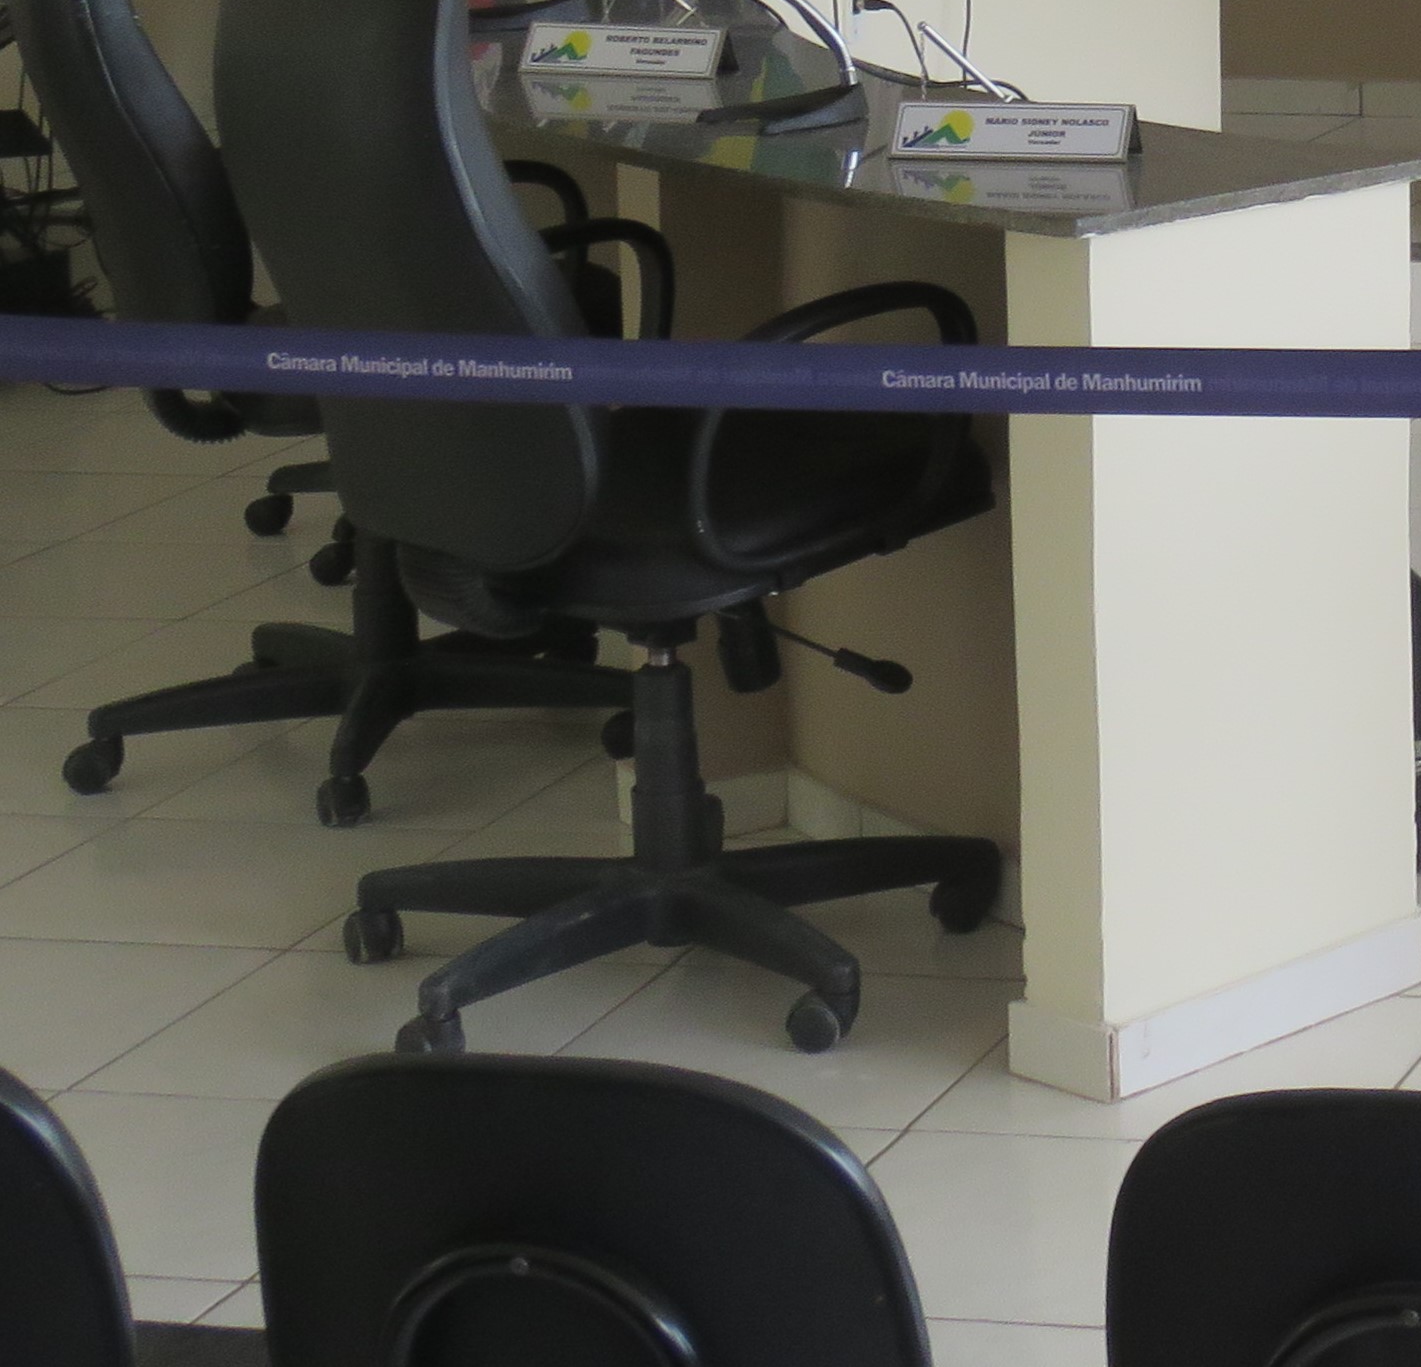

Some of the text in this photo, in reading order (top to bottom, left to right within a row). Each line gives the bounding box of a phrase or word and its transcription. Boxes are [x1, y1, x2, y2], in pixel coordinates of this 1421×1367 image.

[267, 351, 572, 381] Câmara Municipal de Manhumirim
[881, 369, 1203, 394] Câmara Municipal de Manhumirim
